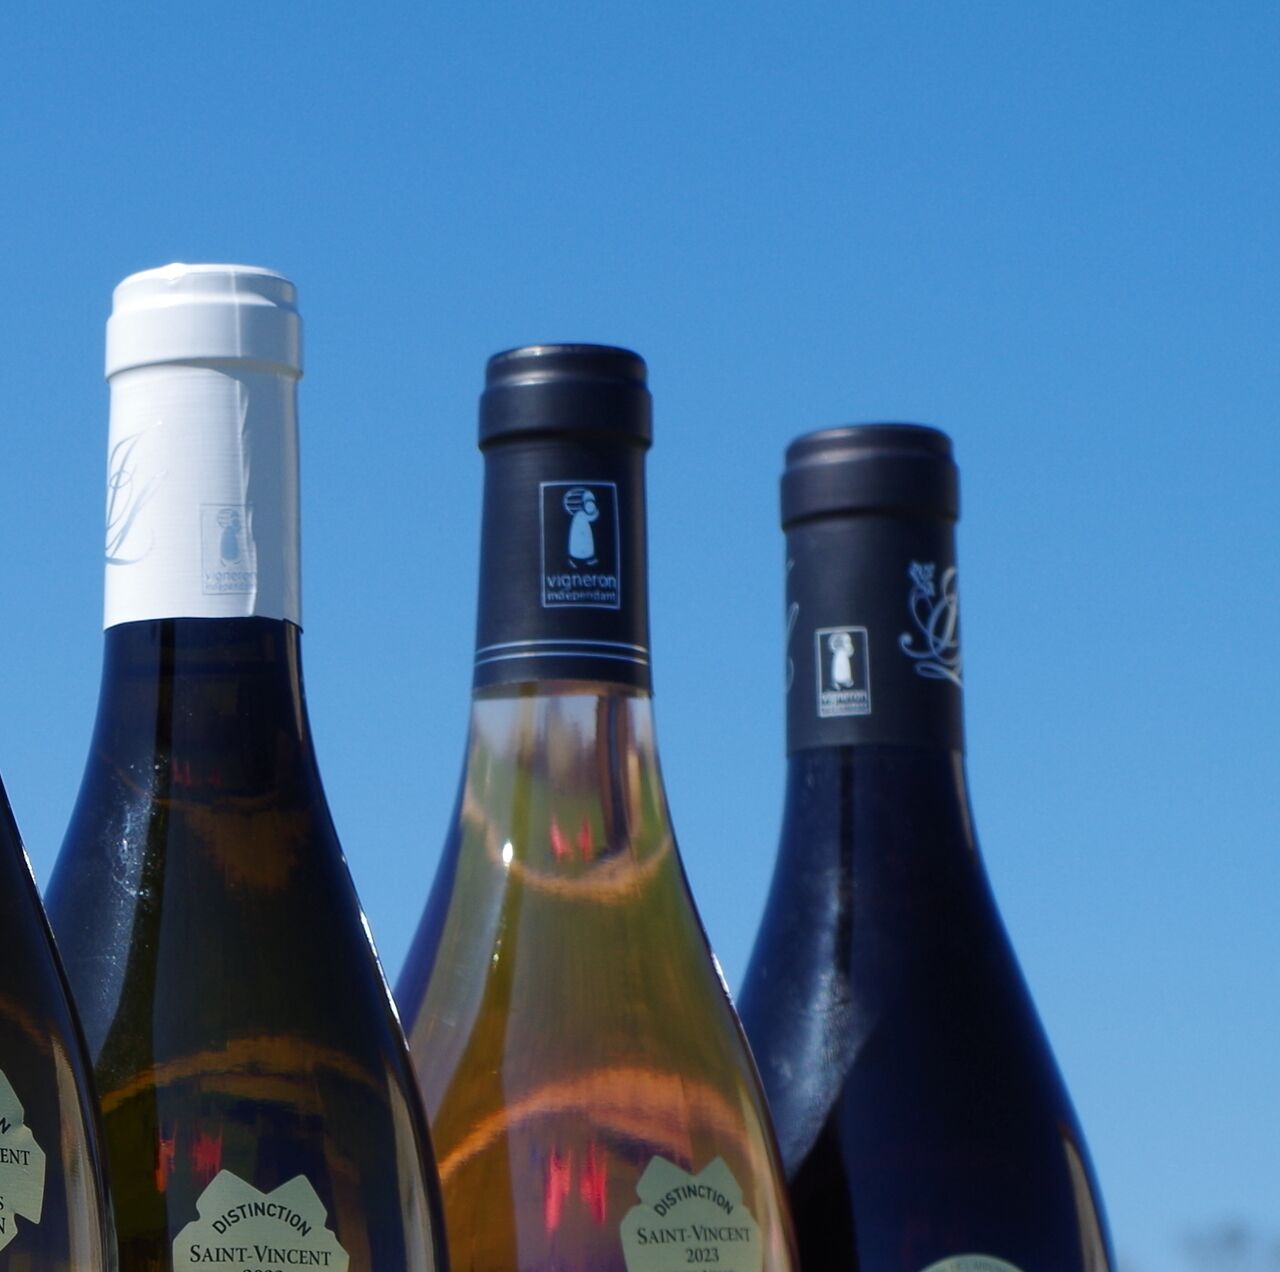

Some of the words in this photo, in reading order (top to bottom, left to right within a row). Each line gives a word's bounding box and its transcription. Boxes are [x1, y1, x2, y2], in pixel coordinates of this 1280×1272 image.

[546, 574, 617, 591] vigneron
[653, 1184, 734, 1217] DISTINCTION
[212, 1202, 312, 1237] DISTINCTION
[637, 1225, 751, 1245] SAINT-VINCENT
[190, 1244, 331, 1266] SAINT-VINCENT
[686, 1247, 720, 1263] 2023
